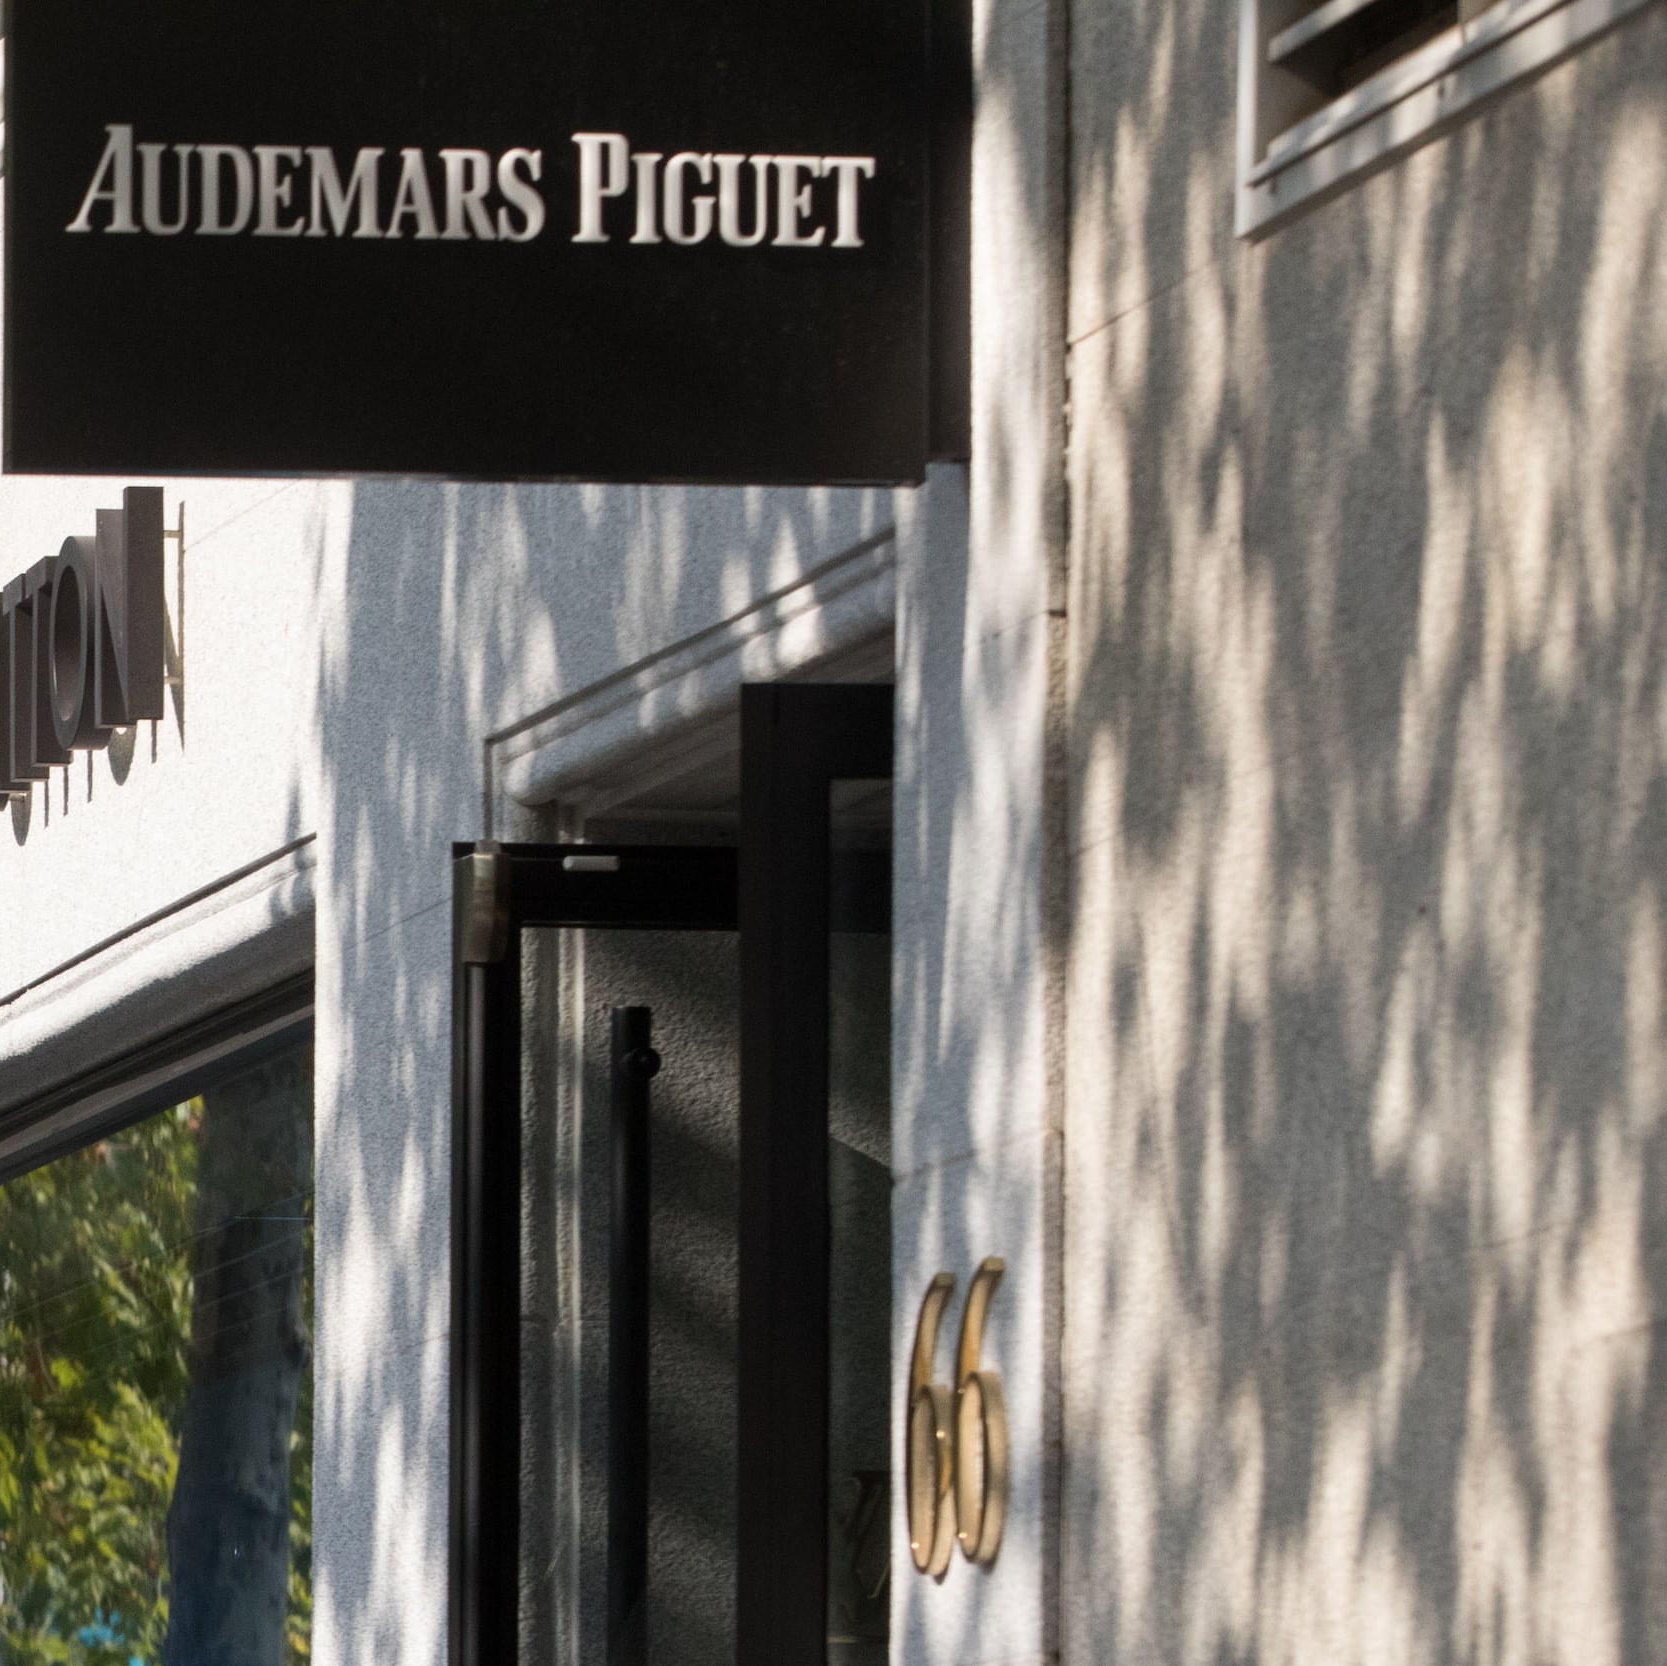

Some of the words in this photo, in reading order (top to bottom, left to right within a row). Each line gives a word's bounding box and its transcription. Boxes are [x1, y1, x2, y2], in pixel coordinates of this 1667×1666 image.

[66, 124, 544, 242] AUDEMARS
[570, 131, 875, 248] PIGUET
[906, 1256, 1010, 1578] 66
